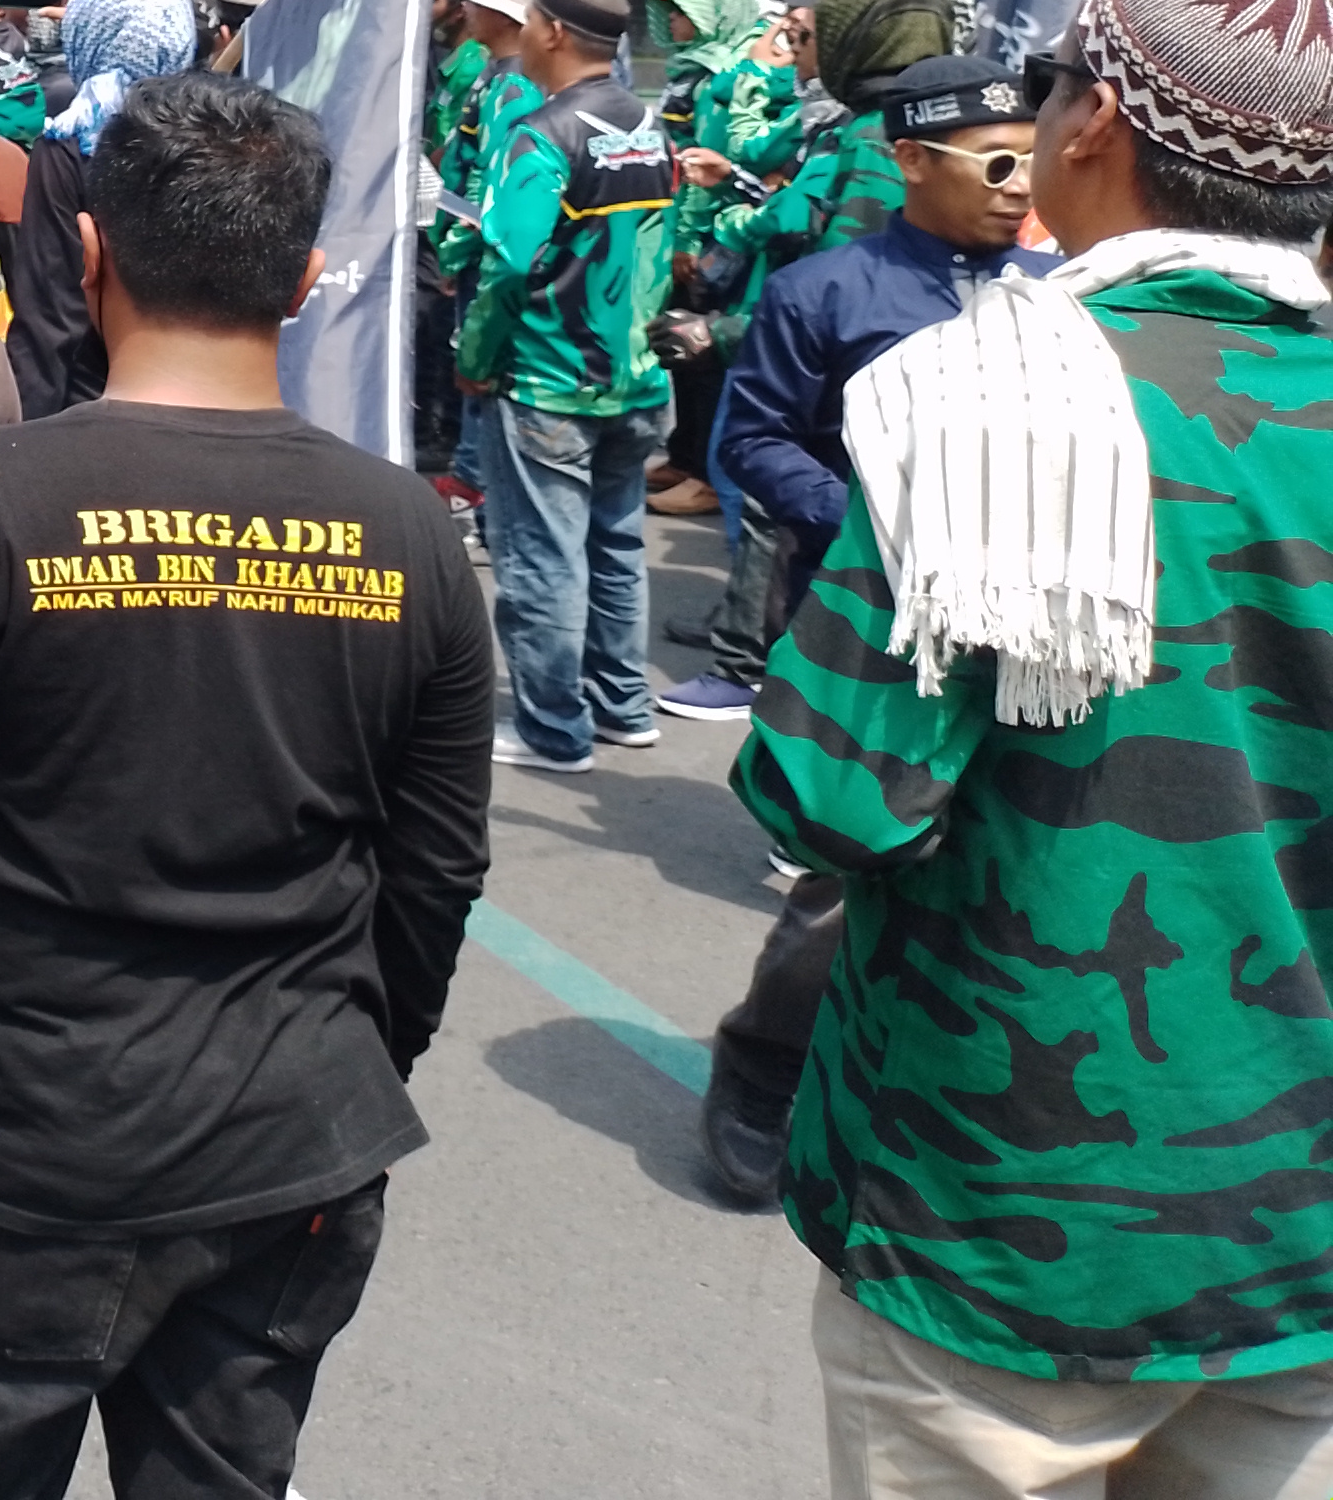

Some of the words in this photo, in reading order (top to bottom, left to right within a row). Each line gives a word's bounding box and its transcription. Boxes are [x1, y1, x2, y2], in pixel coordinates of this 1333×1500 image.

[76, 508, 364, 558] BRIGADE
[26, 554, 138, 587] UMAR
[156, 553, 217, 583] BIN
[235, 556, 405, 599] KHATTAB
[31, 590, 116, 613] AMAR
[121, 589, 221, 609] MA'RUF
[226, 592, 287, 614] NAHI
[293, 596, 402, 623] MUNKAR
